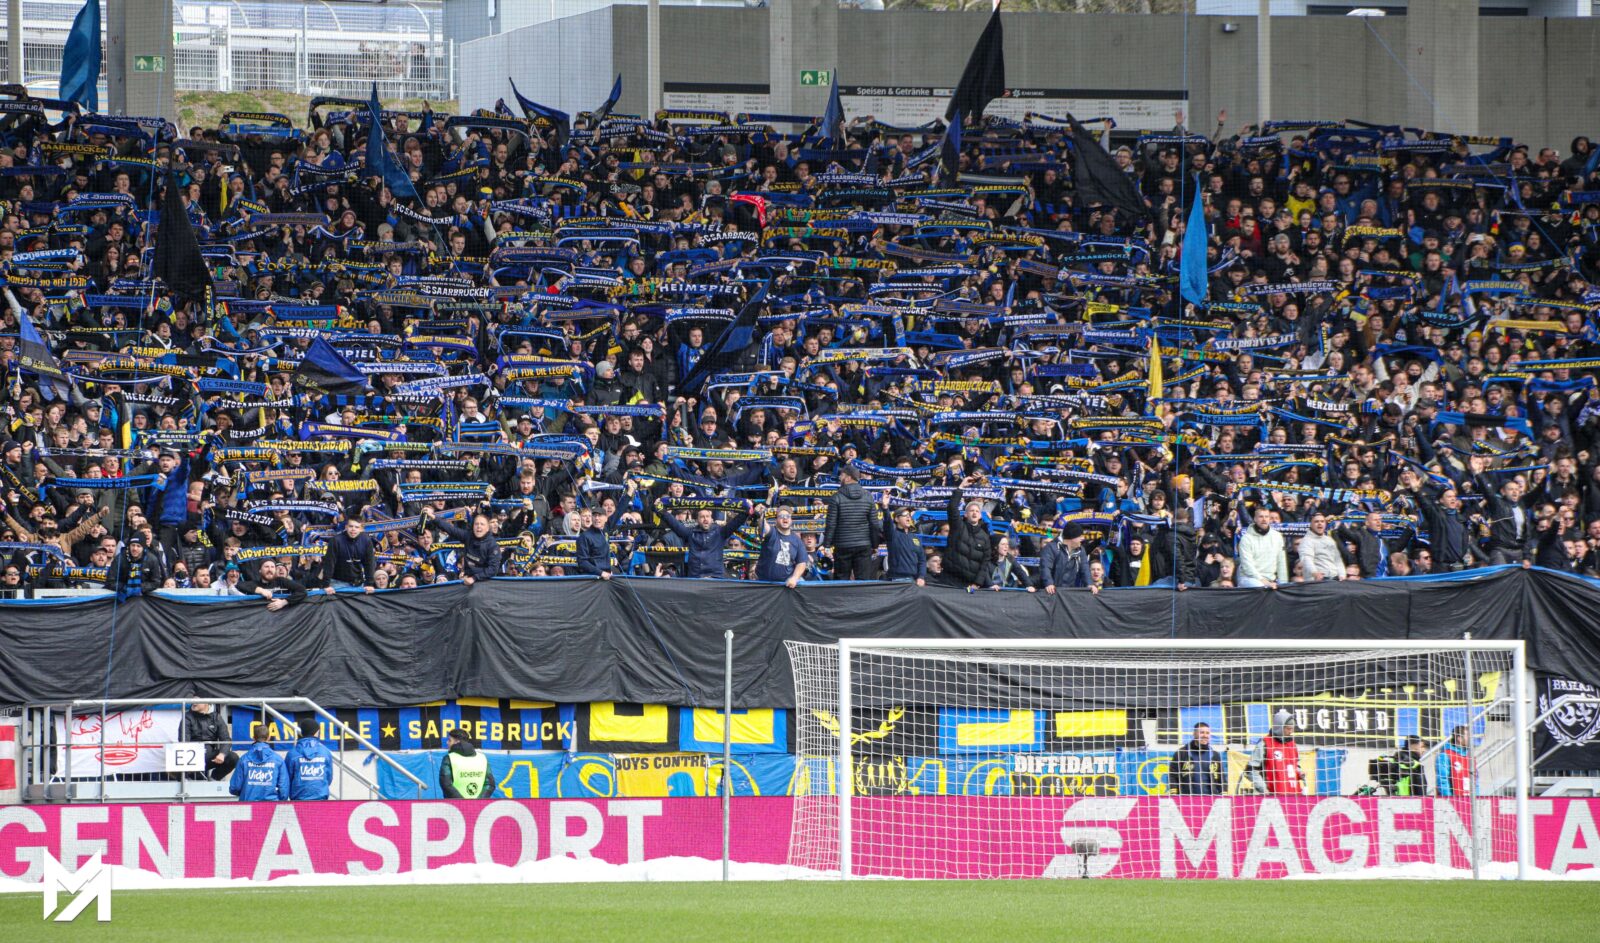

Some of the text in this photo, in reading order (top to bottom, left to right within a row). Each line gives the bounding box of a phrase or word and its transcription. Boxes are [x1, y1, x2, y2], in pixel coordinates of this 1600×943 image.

[857, 87, 886, 97] Speisen
[895, 88, 930, 96] Getränke
[110, 156, 162, 168] SAARBRÜCK
[432, 286, 489, 297] SAARBRÜCKEN
[660, 284, 740, 294] HEIMSPIEL
[1279, 281, 1332, 290] SAARBRÜCKEN
[935, 380, 994, 392] SAARBRÜCKEN
[1307, 399, 1349, 411] HERZBLUT
[244, 450, 256, 459] DIE
[670, 498, 743, 508] Virage Est
[1283, 707, 1390, 731] UGEND
[249, 719, 571, 741] CANILLE SARREBRUCK
[175, 749, 196, 766] E2
[615, 755, 706, 771] BOYS CONTRE
[1014, 755, 1115, 774] DIFFIDATI
[346, 800, 662, 876] SPORT
[1158, 797, 1600, 880] MAGENTA
